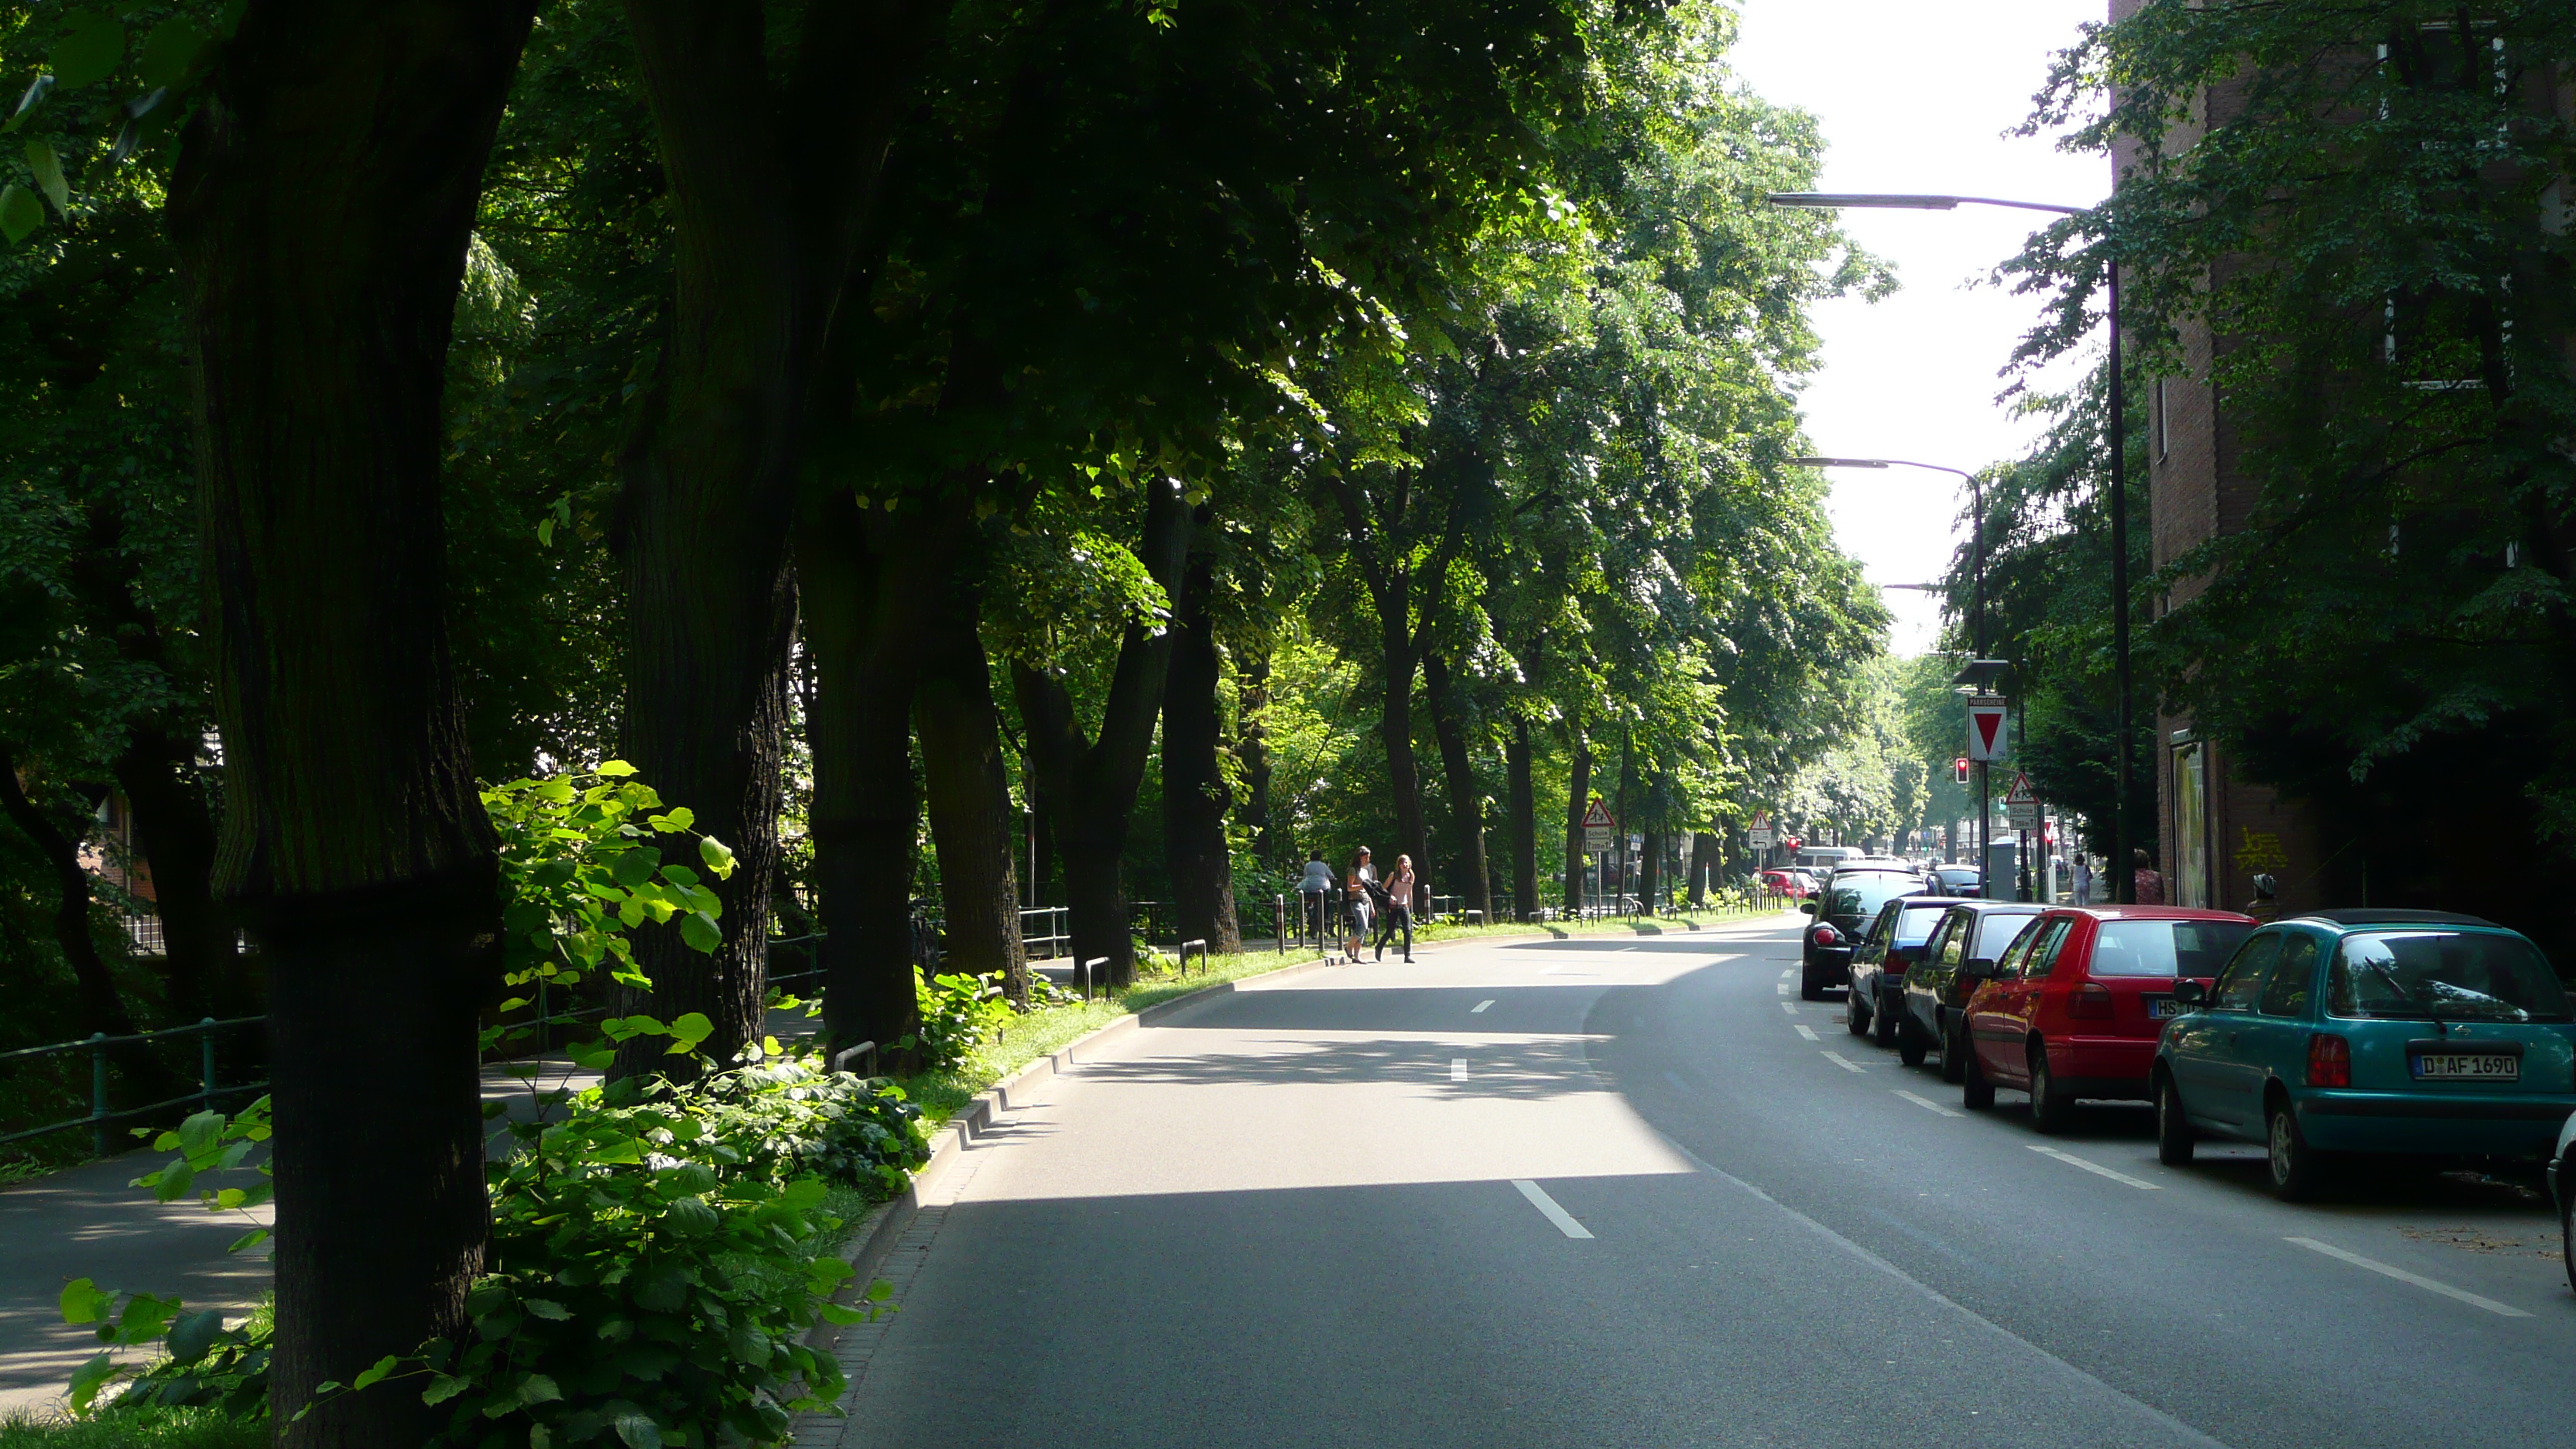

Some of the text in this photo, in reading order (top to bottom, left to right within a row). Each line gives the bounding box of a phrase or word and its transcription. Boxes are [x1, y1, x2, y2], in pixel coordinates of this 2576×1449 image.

[2158, 1001, 2177, 1015] HS
[2423, 1057, 2514, 1074] D AF 1690
